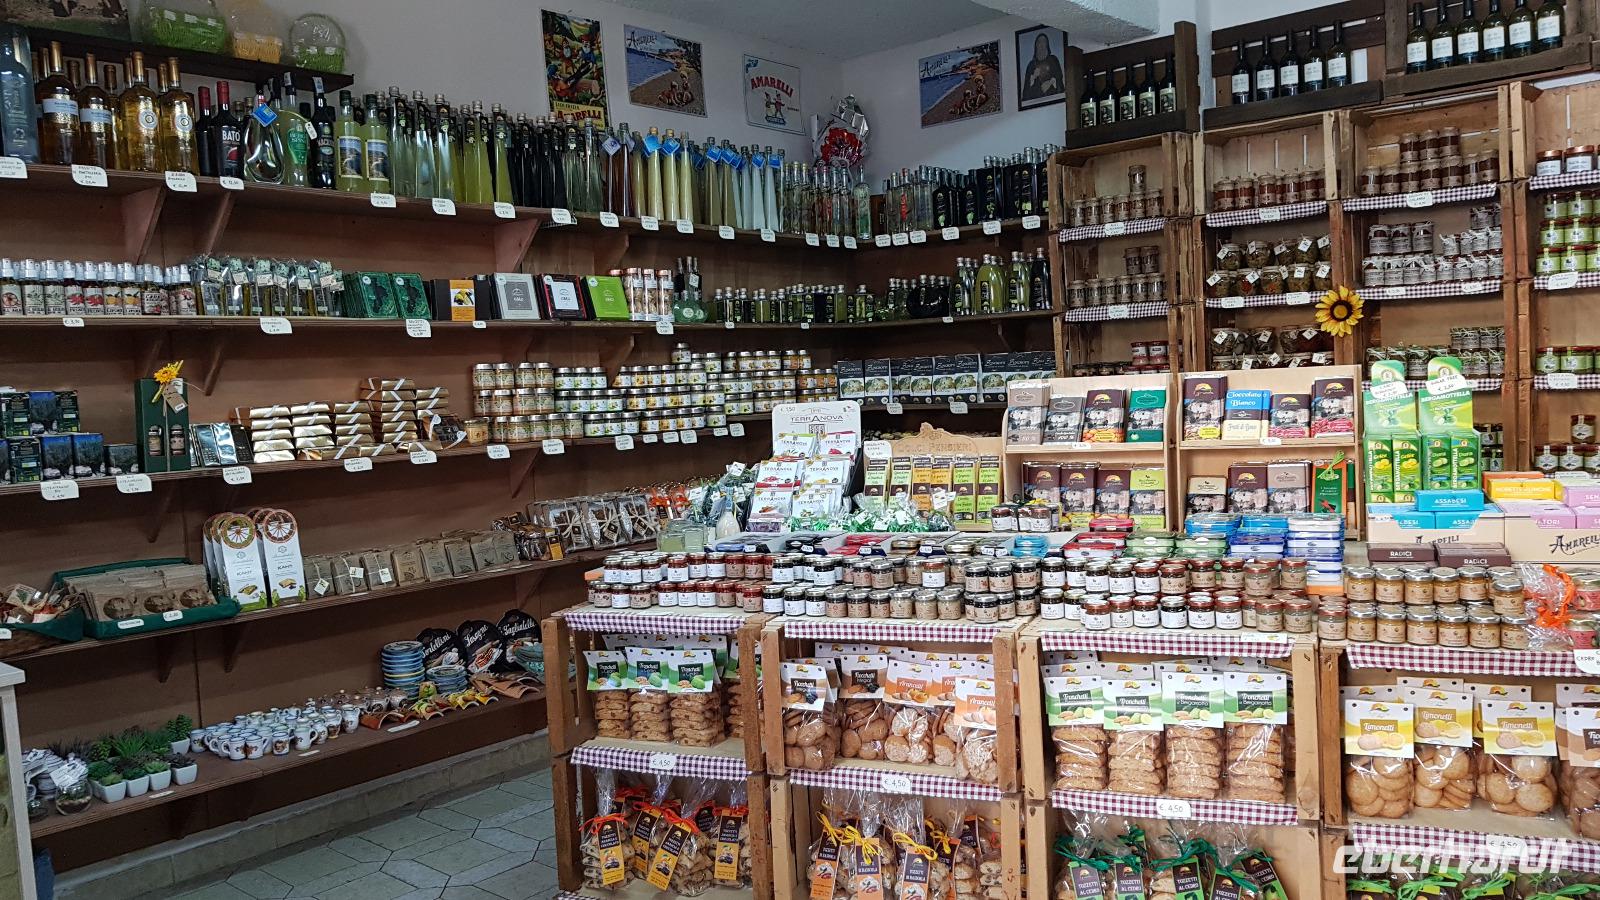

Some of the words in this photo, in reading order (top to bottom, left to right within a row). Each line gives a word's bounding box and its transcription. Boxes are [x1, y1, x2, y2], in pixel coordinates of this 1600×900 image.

[750, 75, 794, 98] AMARELLI
[557, 110, 602, 121] AARELLI
[222, 131, 241, 142] BATO
[1421, 710, 1453, 720] Limonetti
[1363, 722, 1394, 732] Limonetti
[1501, 721, 1534, 729] Limonetti
[891, 779, 906, 788] 4,50
[1167, 804, 1183, 813] 4,50
[1078, 881, 1099, 889] TOZZETTI
[1177, 877, 1198, 885] TOZZETTI
[1215, 889, 1238, 899] TOZZETTI
